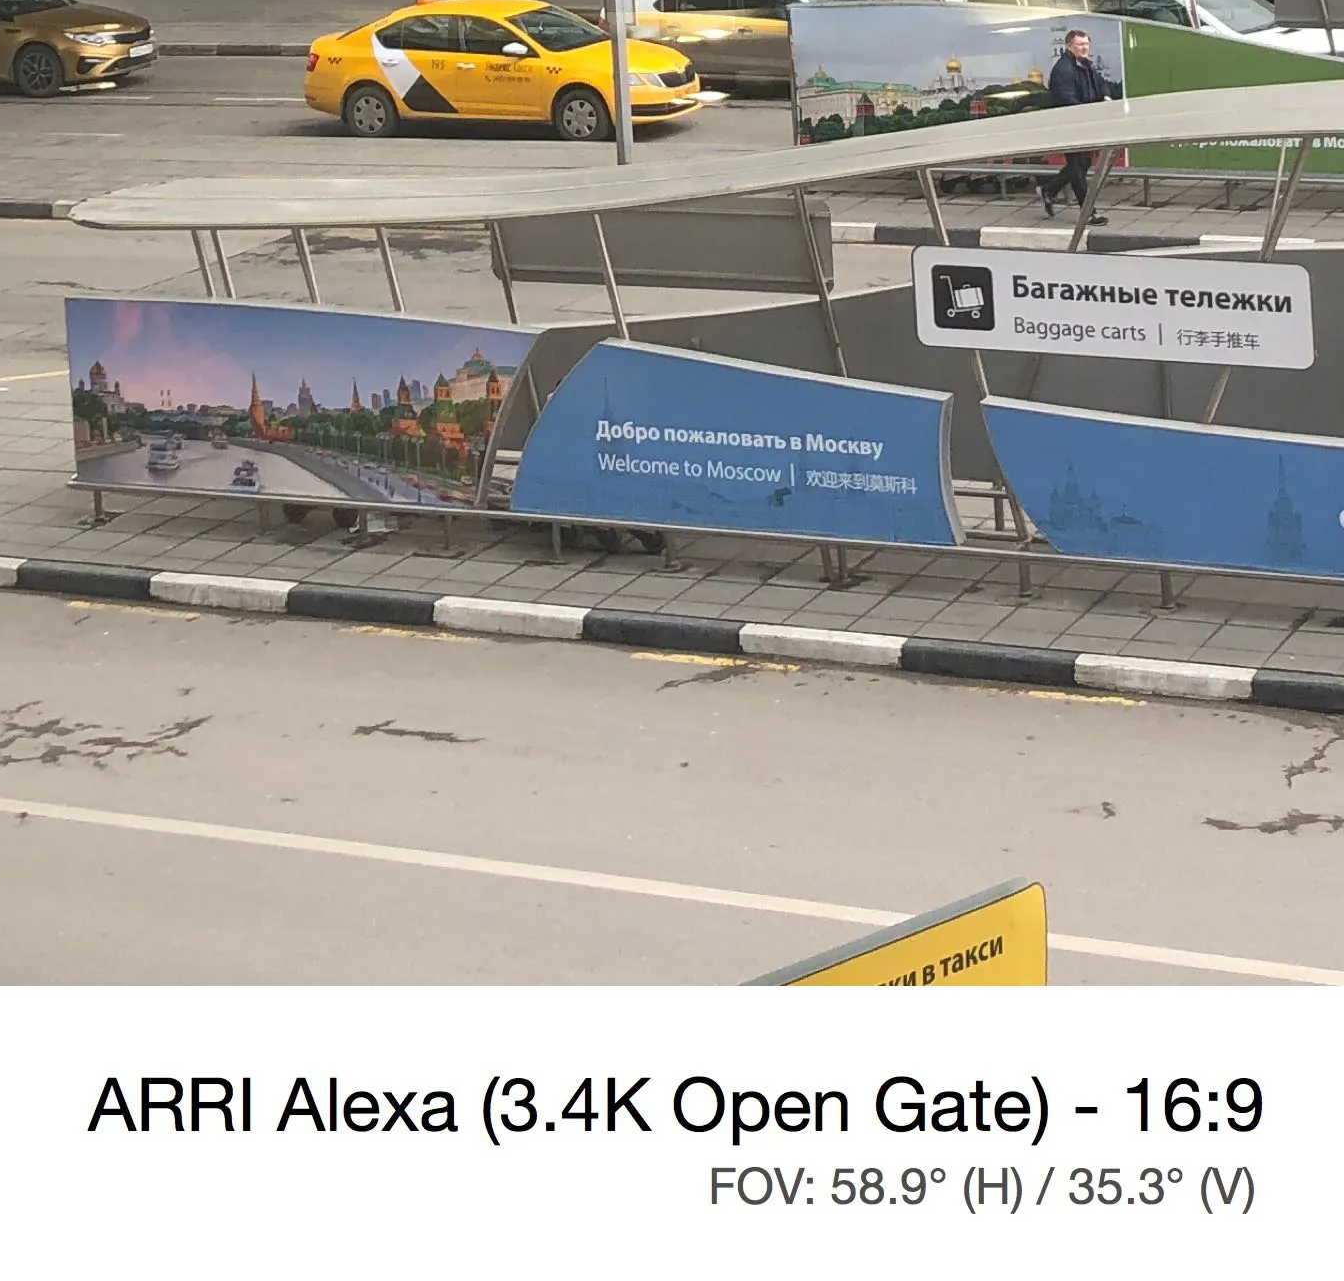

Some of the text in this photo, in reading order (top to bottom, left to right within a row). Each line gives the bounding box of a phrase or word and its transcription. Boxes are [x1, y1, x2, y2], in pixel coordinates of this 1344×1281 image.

[1012, 275, 1292, 313] Багажные тележки
[1014, 317, 1146, 342] Baggage carts
[1176, 329, 1260, 349] 行李手推车
[596, 420, 883, 460] Добро пожаловать в Москву
[597, 453, 781, 483] Welcome to Moscow
[805, 469, 918, 495] 欢迎来到莫斯科
[939, 935, 1004, 978] такси
